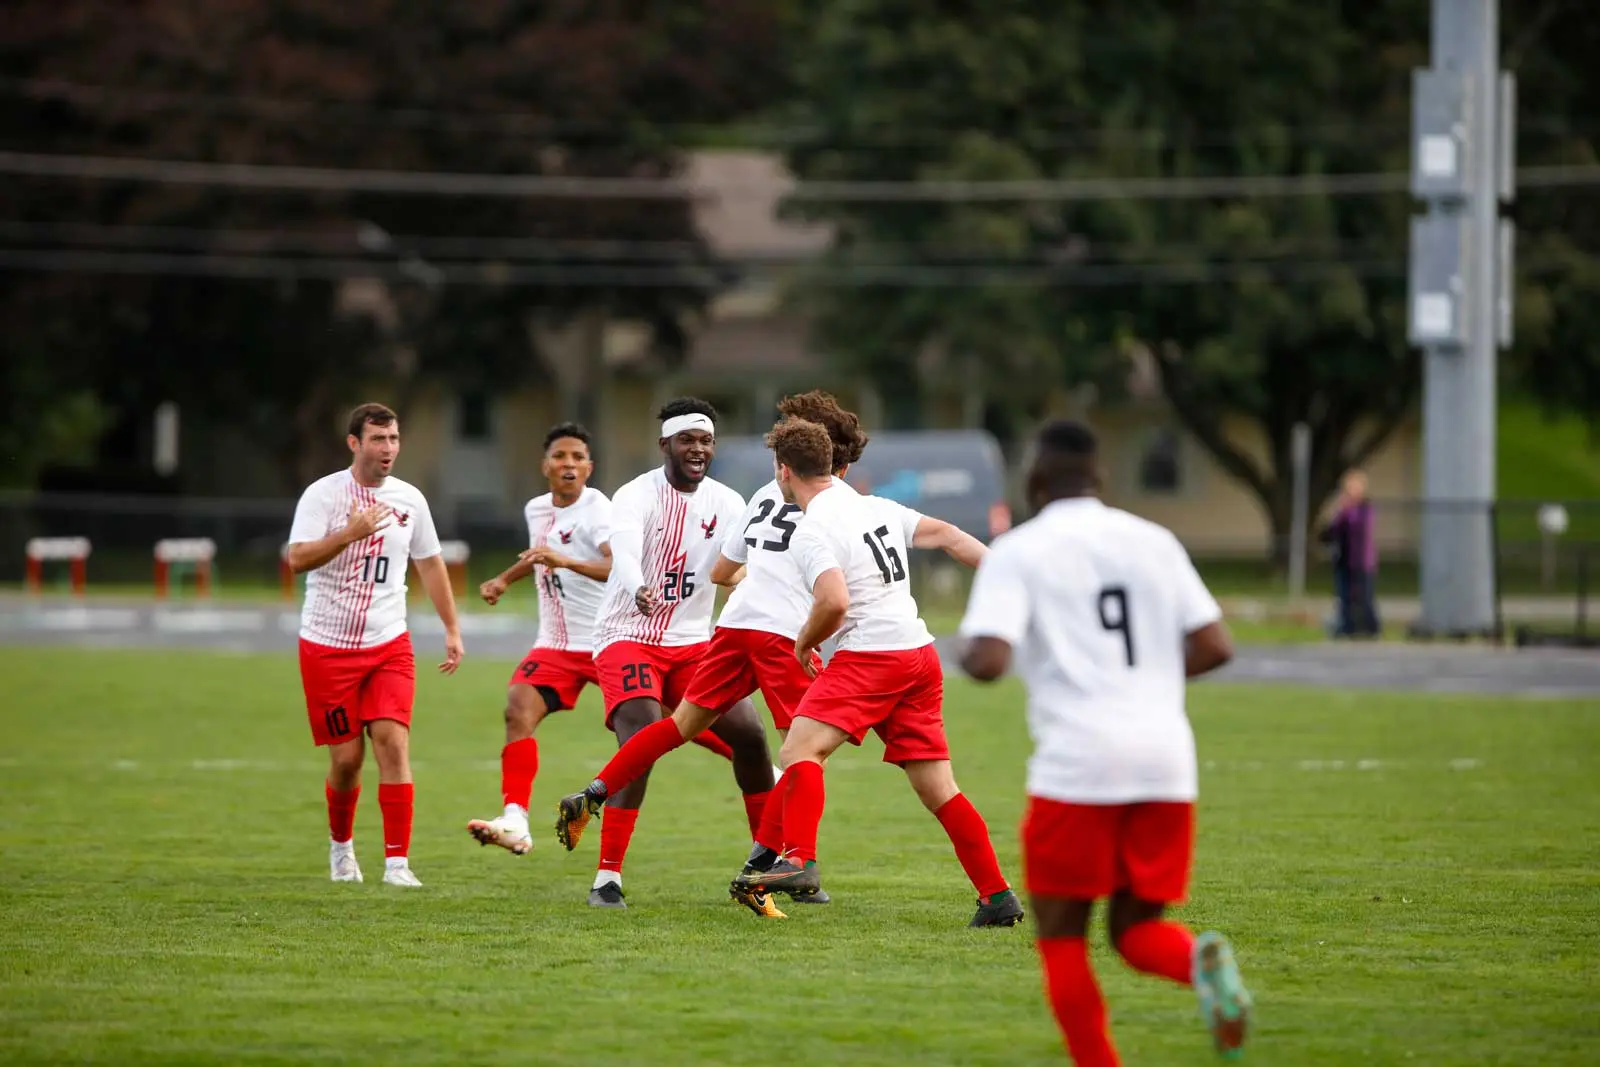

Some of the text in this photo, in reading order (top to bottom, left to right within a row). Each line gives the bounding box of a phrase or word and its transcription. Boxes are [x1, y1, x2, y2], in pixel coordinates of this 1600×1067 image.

[743, 498, 803, 552] 25
[363, 555, 389, 583] 10
[664, 571, 695, 600] 26
[1097, 585, 1134, 667] 9
[621, 663, 652, 692] 26
[325, 705, 350, 738] 10
